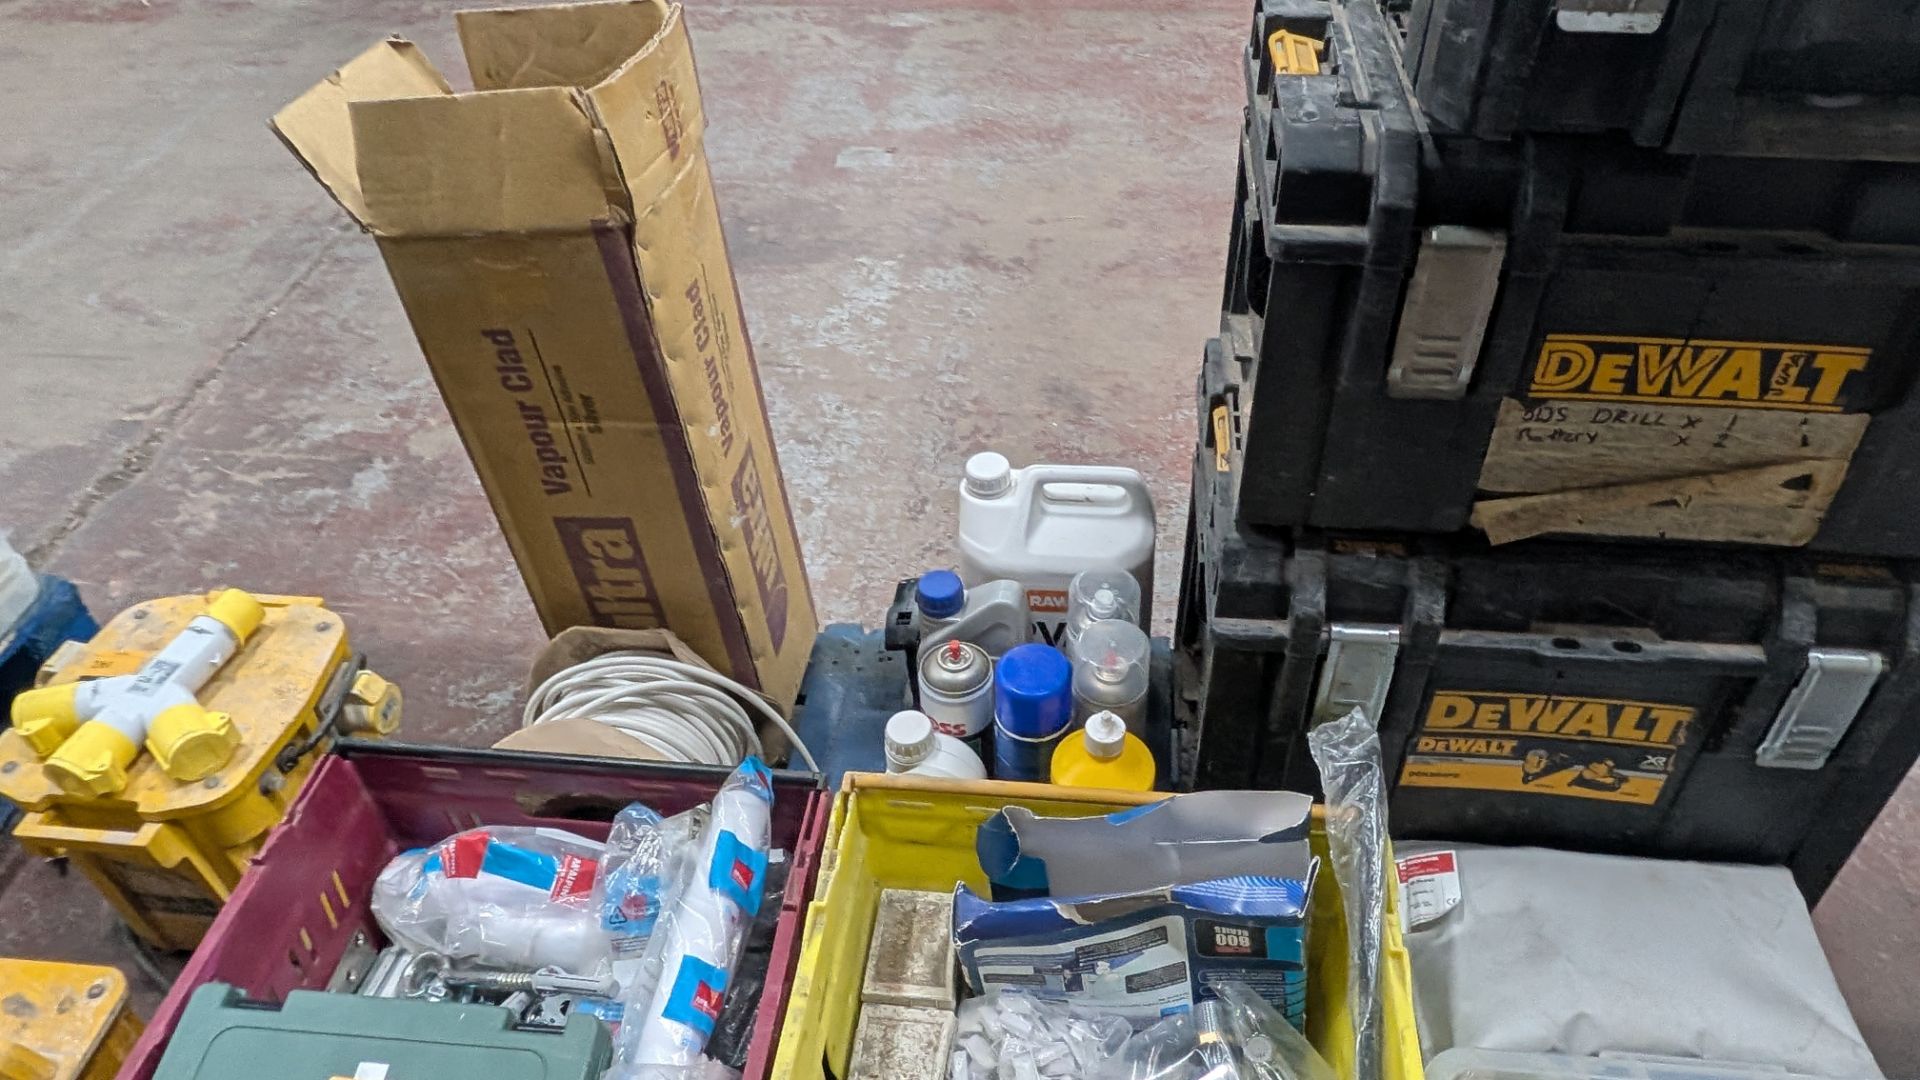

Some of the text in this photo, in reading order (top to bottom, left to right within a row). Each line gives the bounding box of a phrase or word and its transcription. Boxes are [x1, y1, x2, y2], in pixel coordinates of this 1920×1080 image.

[685, 277, 710, 352] Clad
[481, 328, 534, 393] Clad
[704, 356, 734, 459] Vapour
[1590, 408, 1666, 426] DRILL
[516, 399, 572, 496] Vapour
[1416, 736, 1519, 756] DEWALT
[1426, 695, 1695, 744] DEWALT
